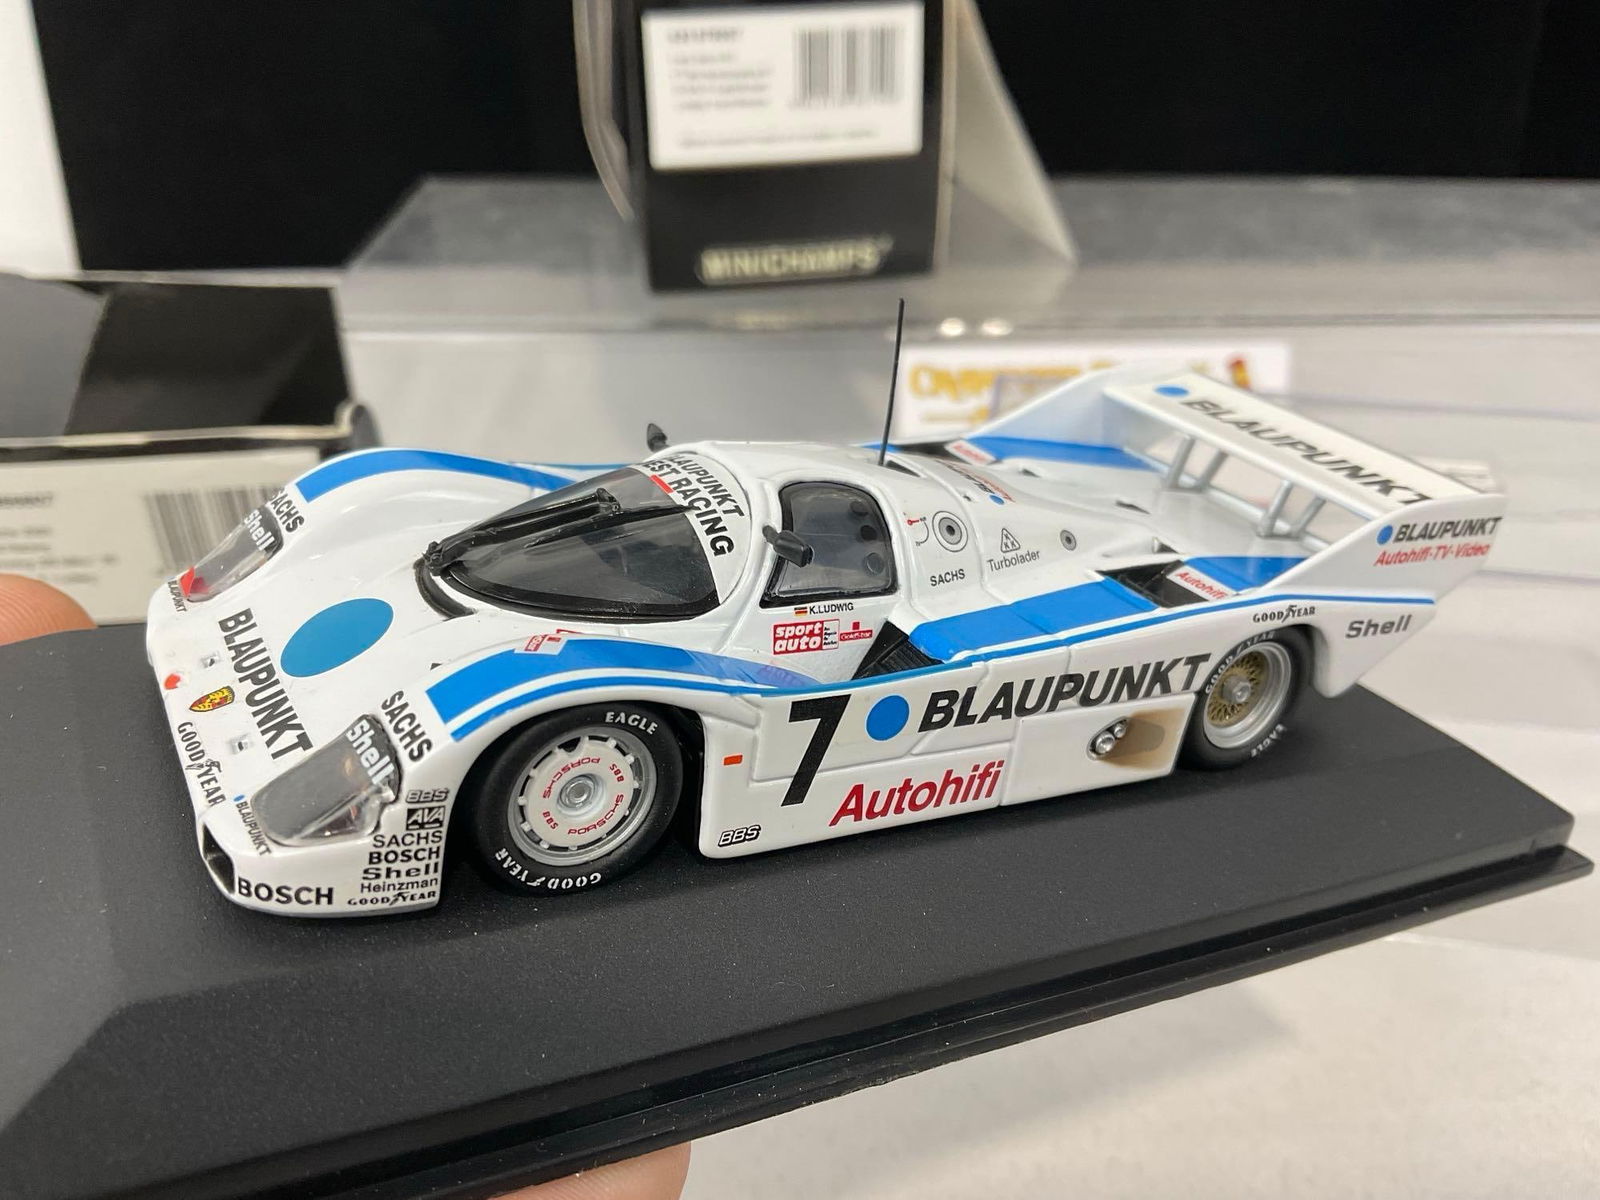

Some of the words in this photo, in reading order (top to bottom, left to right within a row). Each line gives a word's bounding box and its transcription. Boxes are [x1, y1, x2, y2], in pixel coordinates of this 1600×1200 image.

[1180, 398, 1433, 504] BLAUPUNKT
[668, 477, 735, 557] RACING
[244, 509, 275, 551] Shell
[1393, 516, 1502, 543] BLAUPUNKT
[986, 550, 1040, 572] Turbolader
[930, 568, 966, 587] SACHS
[809, 602, 854, 615] K.LUDWIG
[774, 621, 823, 639] sport
[1345, 614, 1412, 638] Shell
[774, 636, 821, 653] auto
[218, 607, 314, 760] BLAUPUNKT
[917, 654, 1211, 733] BLAUPUNKT
[381, 690, 433, 762] SACHS
[605, 711, 658, 735] EAGLE
[346, 719, 395, 785] Shell
[780, 694, 851, 807] 7
[405, 788, 450, 804] BBS
[828, 760, 1004, 827] Autohifi
[235, 801, 272, 856] BLAUPUNKT
[373, 830, 443, 848] SACHS
[718, 824, 762, 847] BBS
[368, 845, 440, 866] BOSCH
[362, 861, 440, 881] Shell
[238, 876, 334, 906] BOSCH
[360, 878, 439, 894] Heinzman
